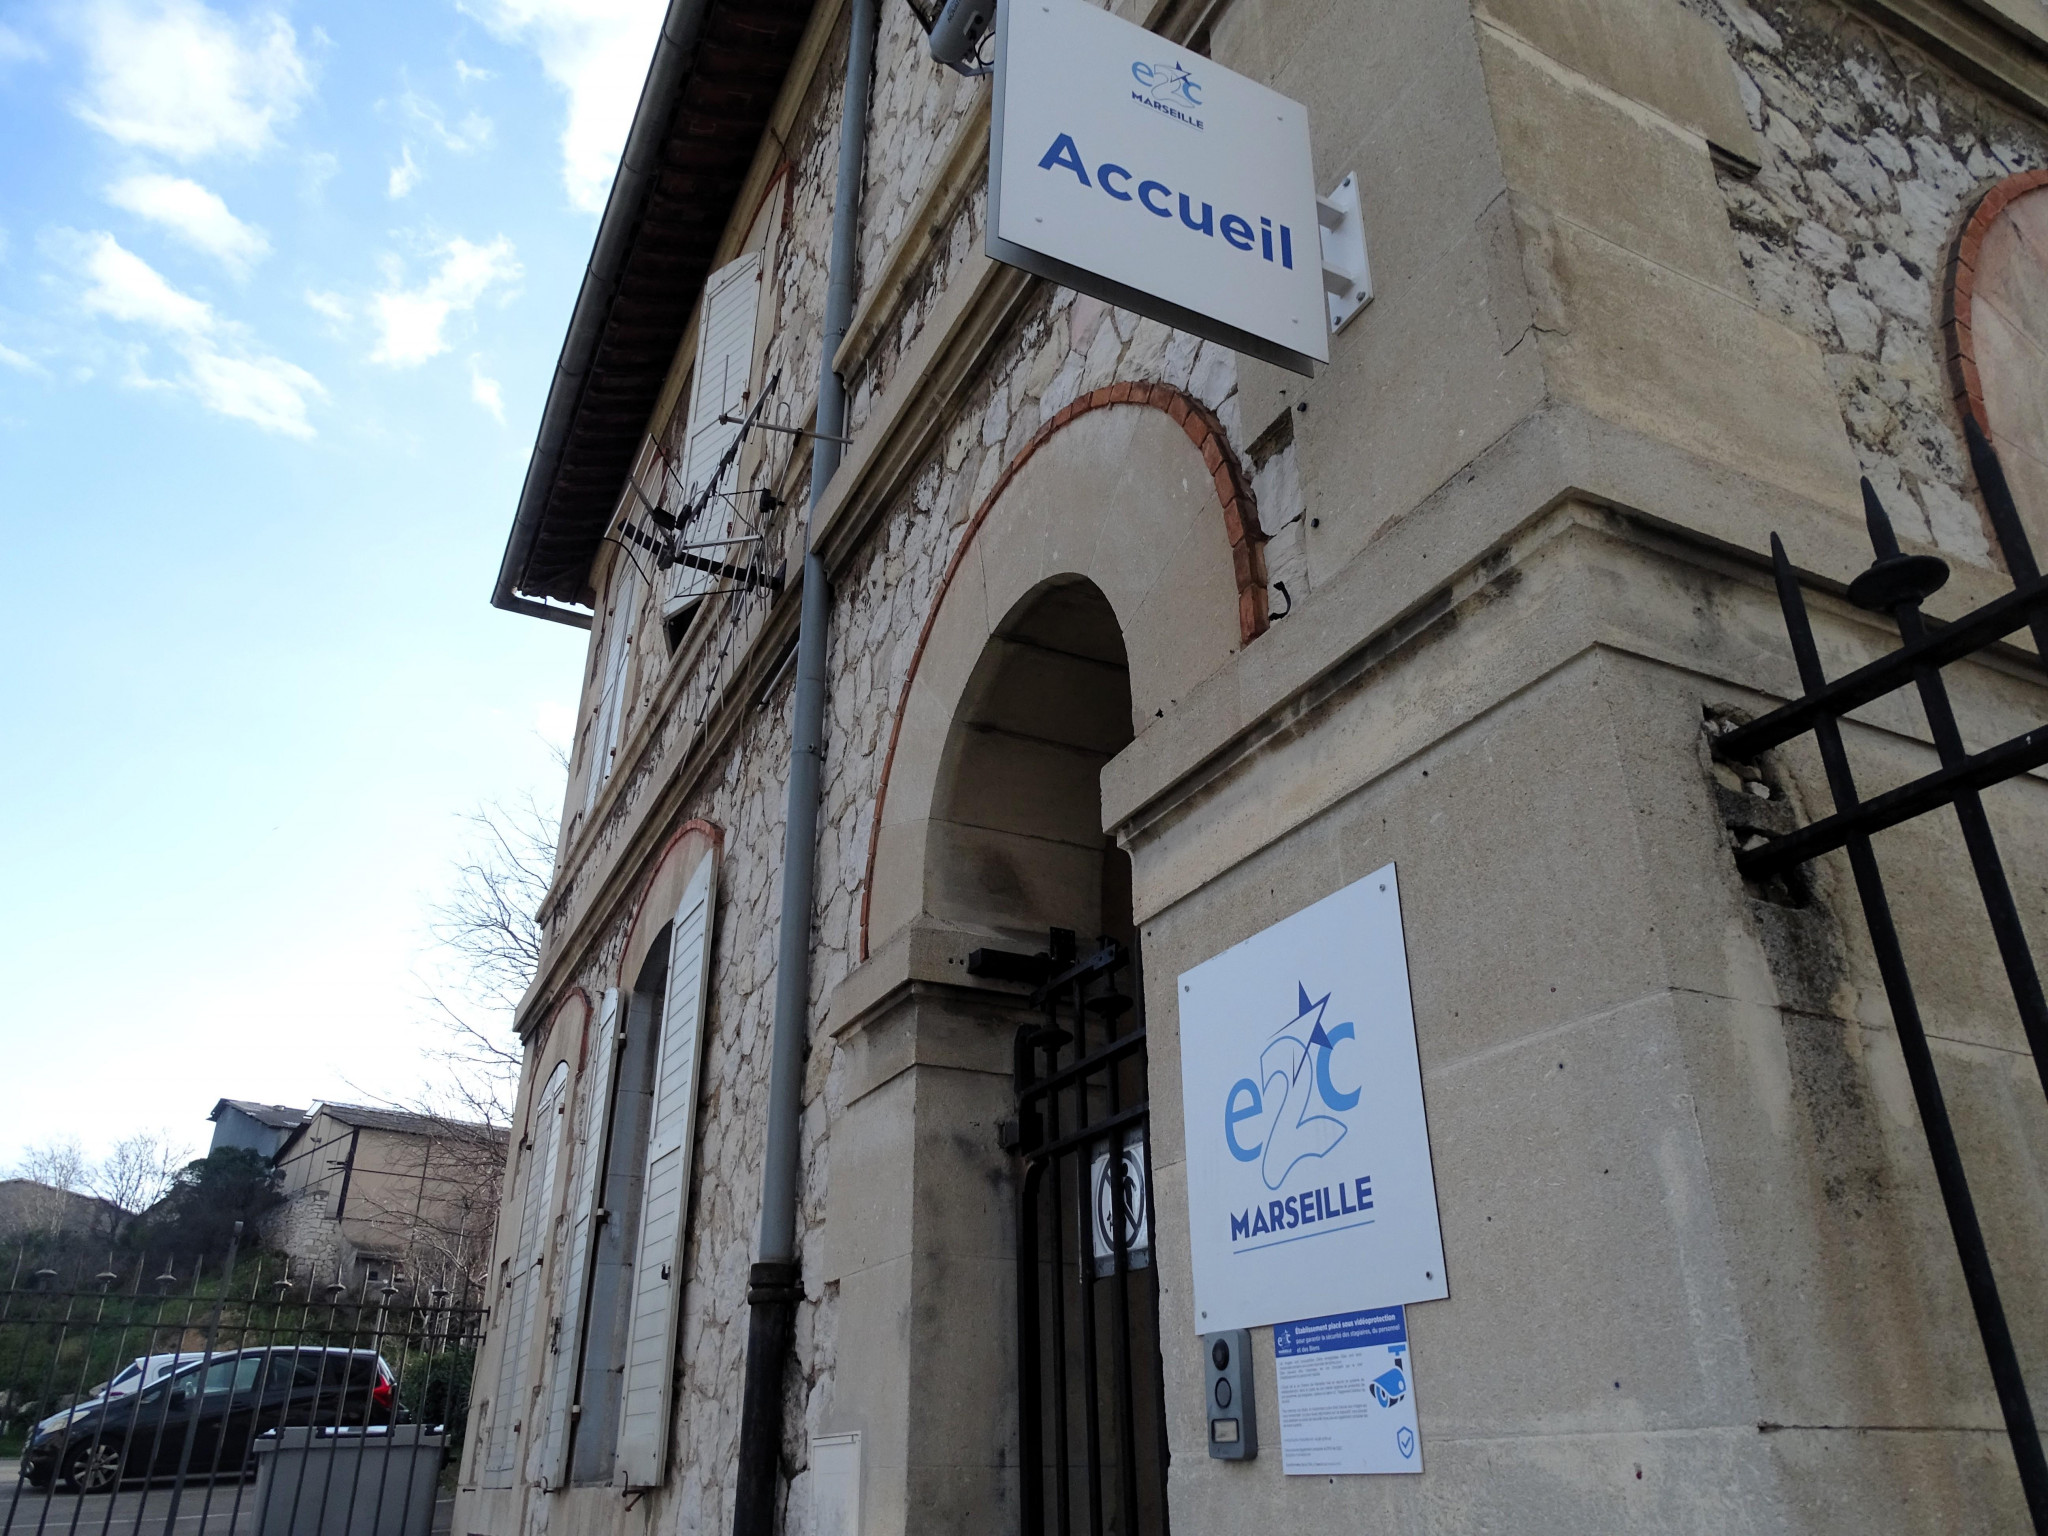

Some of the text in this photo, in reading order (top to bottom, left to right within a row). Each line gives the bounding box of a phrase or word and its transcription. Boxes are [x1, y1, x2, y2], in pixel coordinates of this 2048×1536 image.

[1131, 91, 1204, 130] MARSEILLE
[1037, 132, 1293, 270] Accueil
[1230, 1175, 1374, 1242] MARSEILLE
